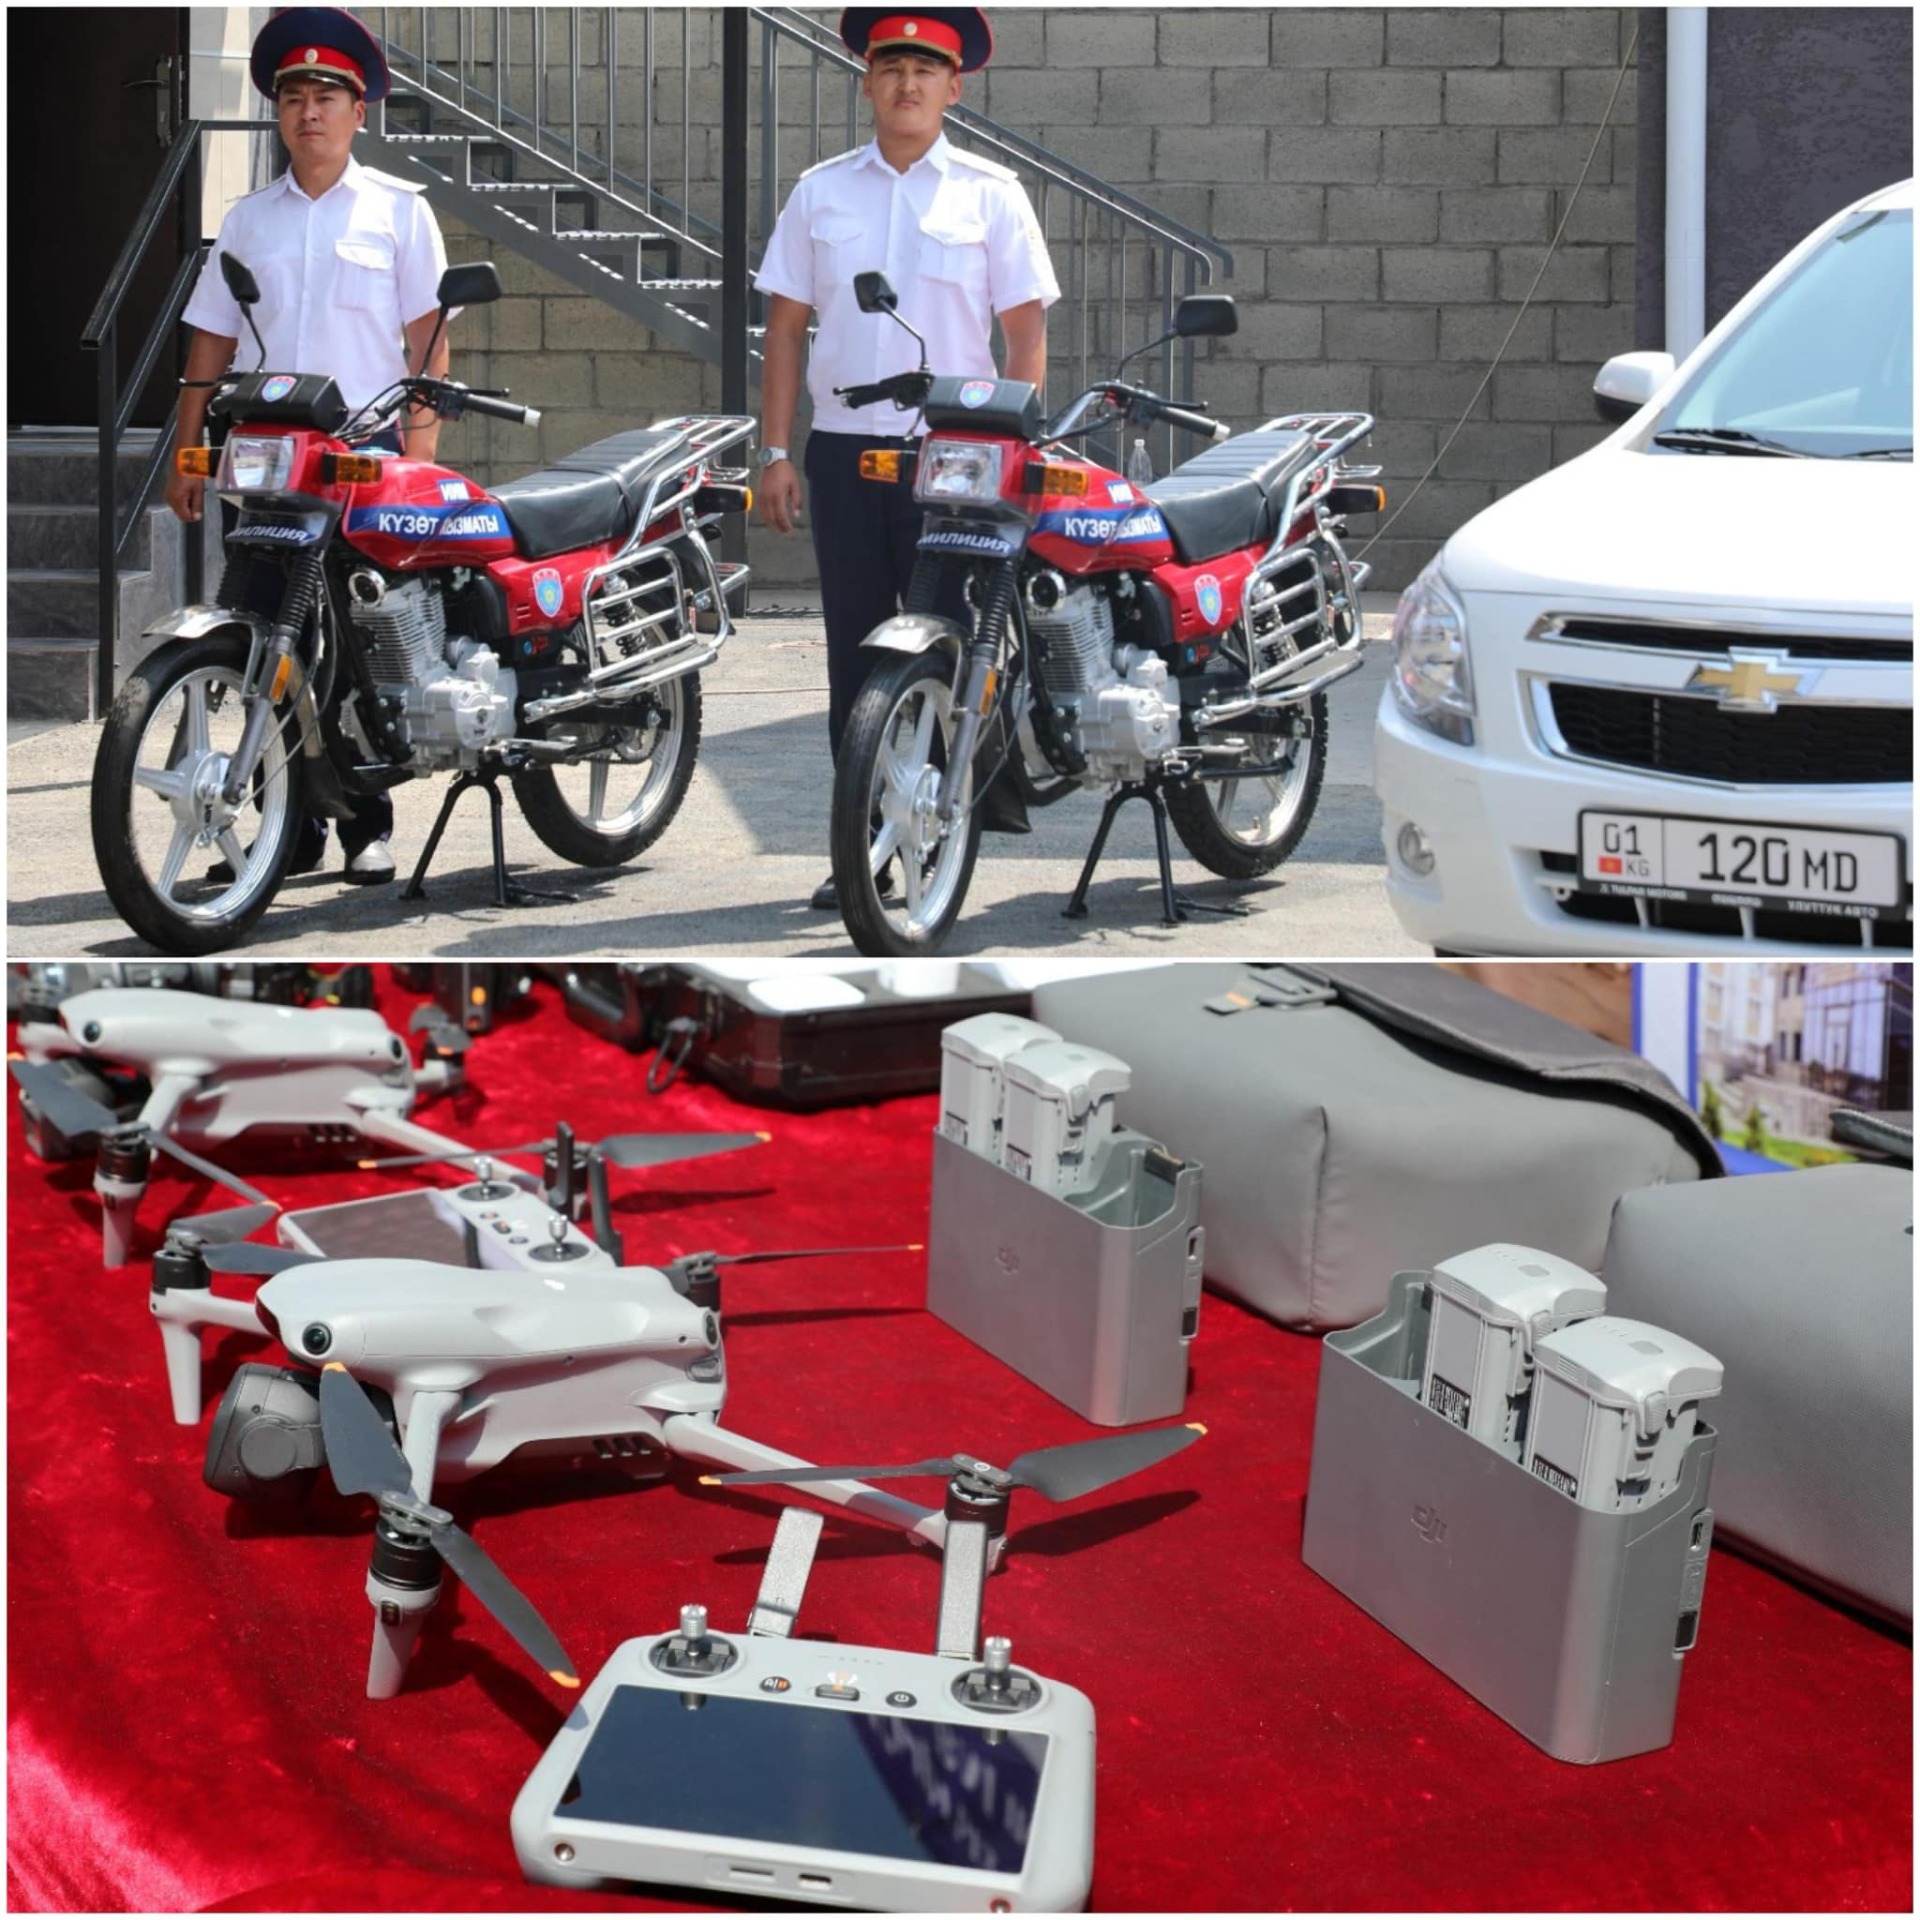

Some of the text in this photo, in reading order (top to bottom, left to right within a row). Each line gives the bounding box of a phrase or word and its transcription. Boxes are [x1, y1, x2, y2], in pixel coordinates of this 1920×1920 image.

[378, 513, 438, 535] КҮЗӨТ
[1603, 823, 1642, 856] 01
[1626, 858, 1650, 878] KG
[1698, 832, 1858, 892] 120 MD
